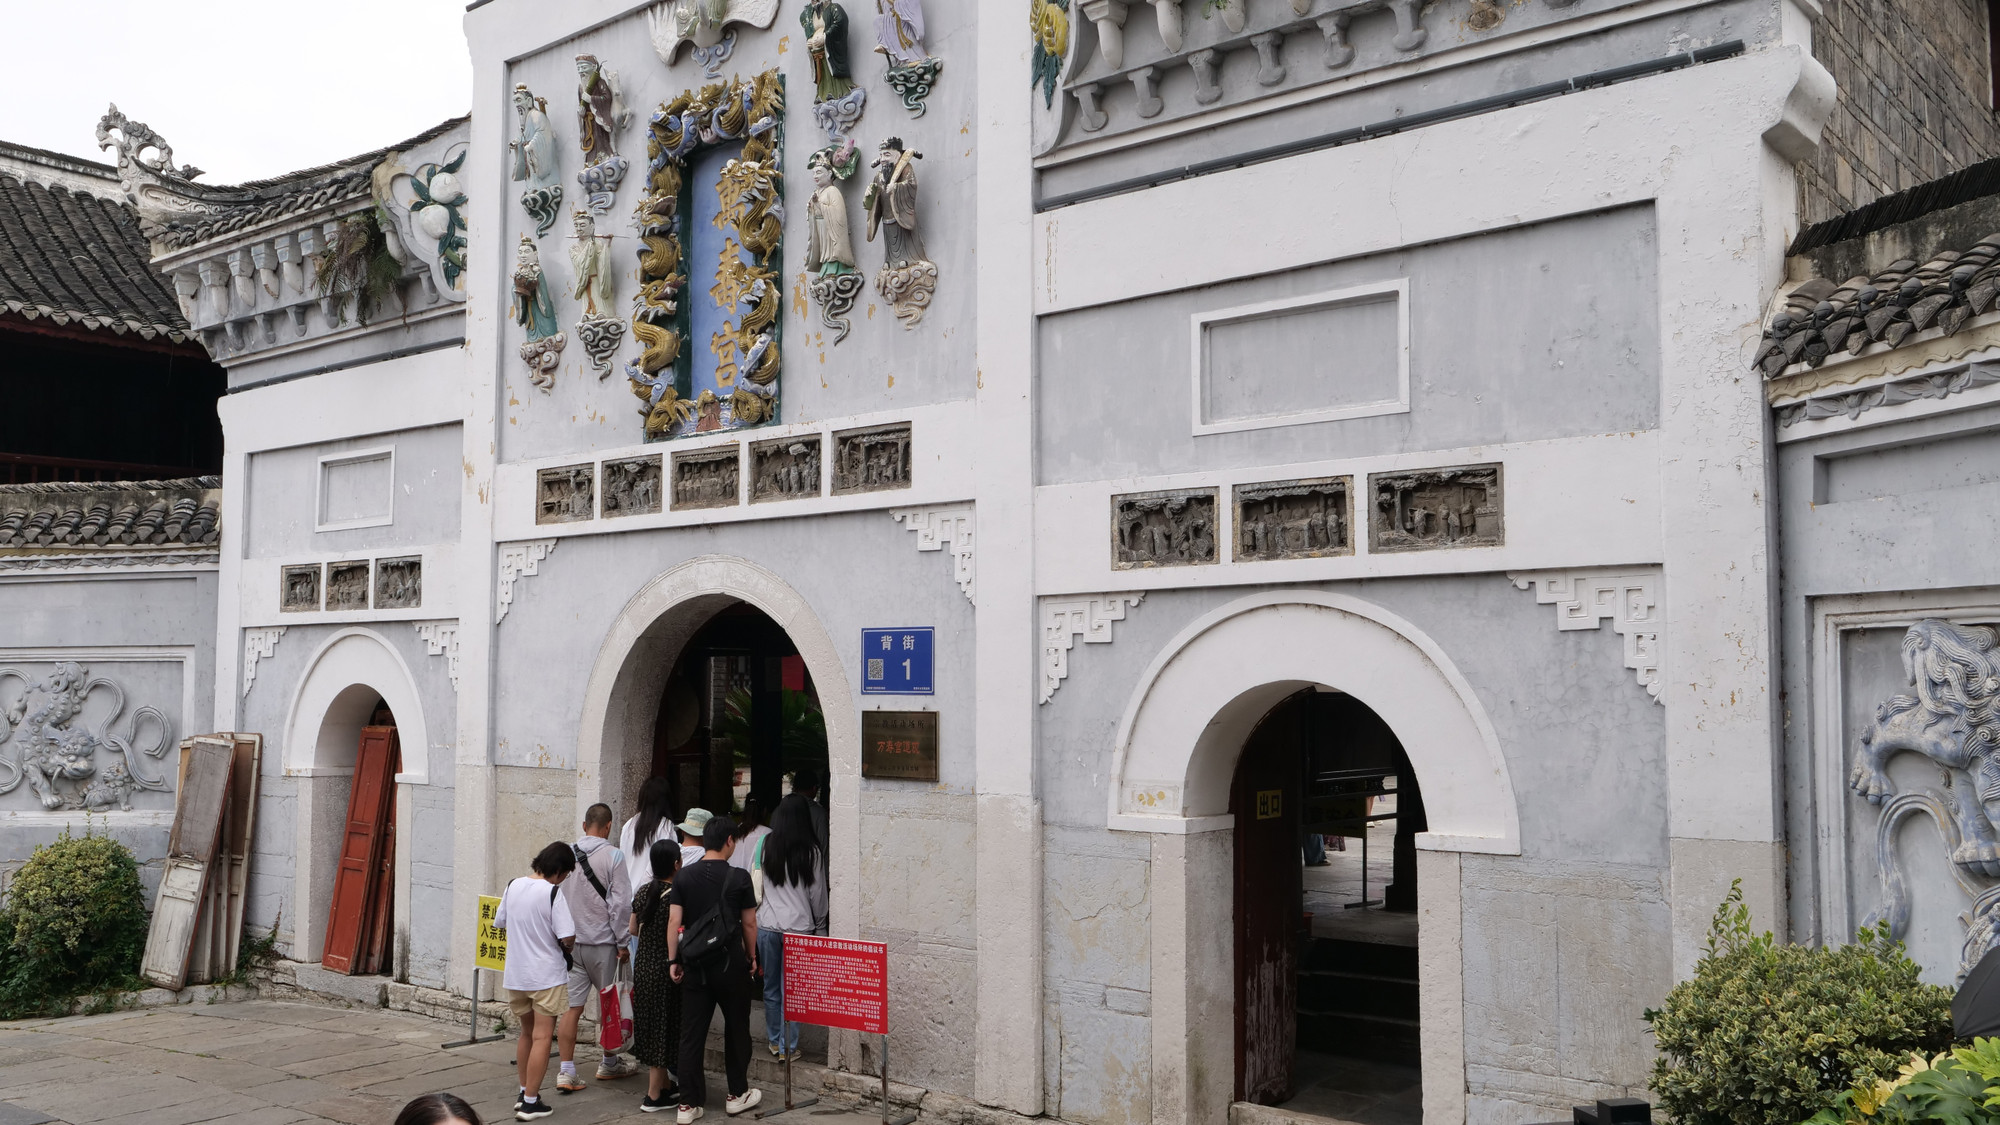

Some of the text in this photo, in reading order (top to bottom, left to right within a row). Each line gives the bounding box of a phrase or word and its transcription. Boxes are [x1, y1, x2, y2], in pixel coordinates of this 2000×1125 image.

[880, 634, 915, 651] 背街
[902, 658, 911, 681] 1
[1259, 793, 1280, 816] 出口
[479, 941, 506, 961] 参加宗
